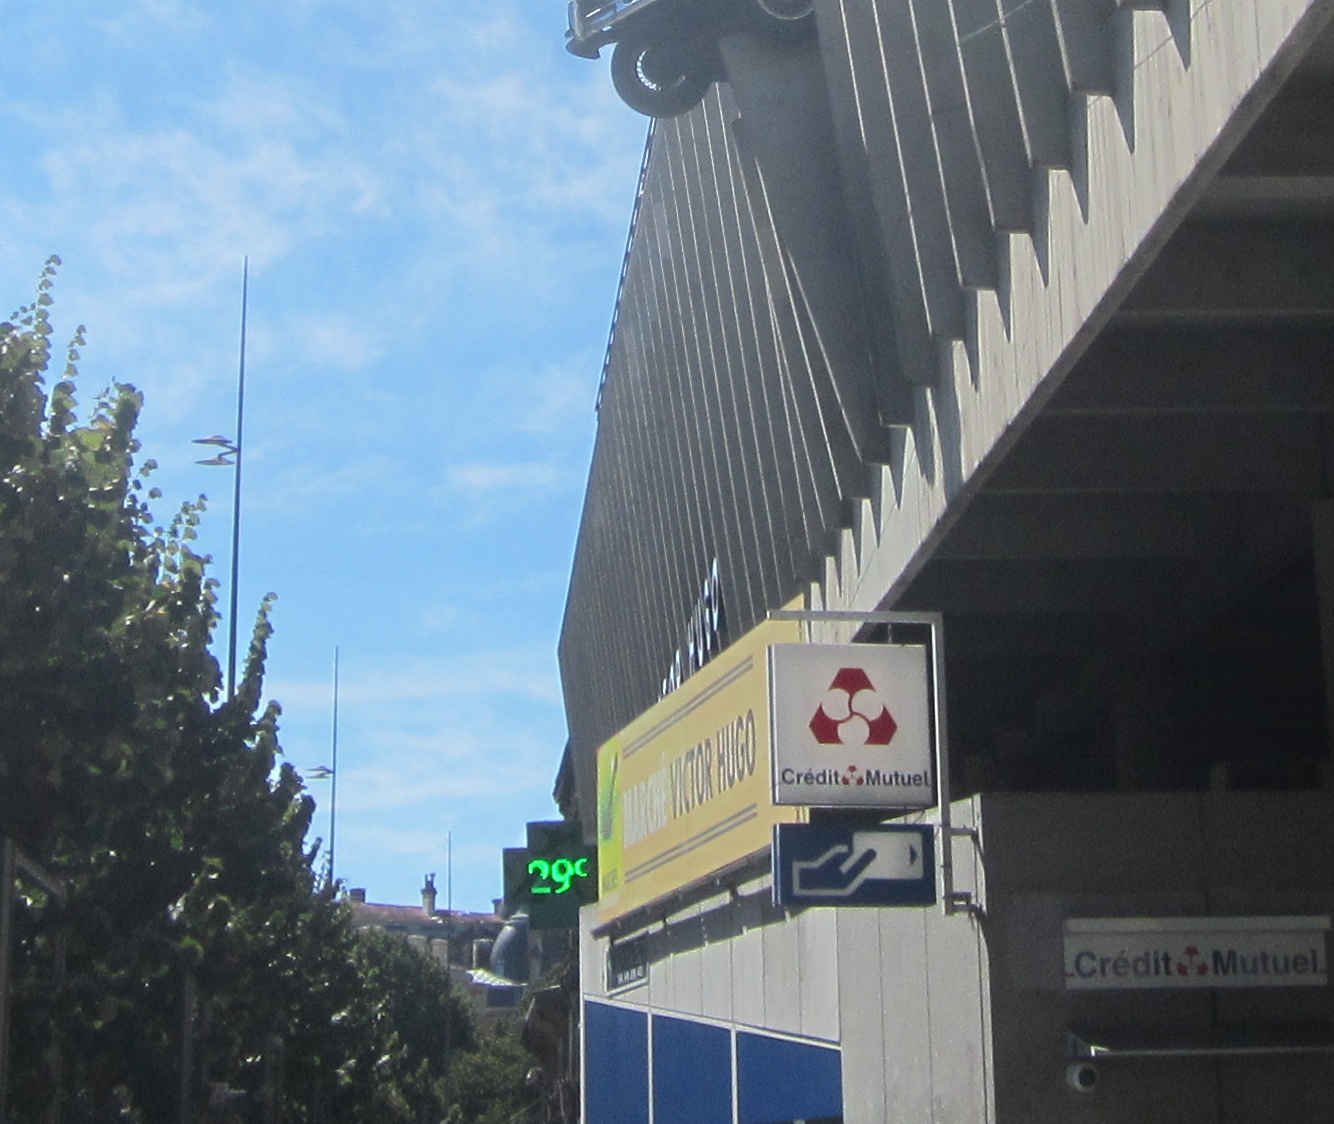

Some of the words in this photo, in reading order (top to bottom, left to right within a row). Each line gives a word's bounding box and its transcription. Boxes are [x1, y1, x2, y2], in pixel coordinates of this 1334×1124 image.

[670, 737, 714, 820] VICTOR
[716, 708, 756, 795] HUGO
[781, 767, 840, 786] Crédit
[866, 769, 929, 787] Mutuel
[1073, 950, 1171, 977] Crédit
[1211, 949, 1318, 975] Mutuel
